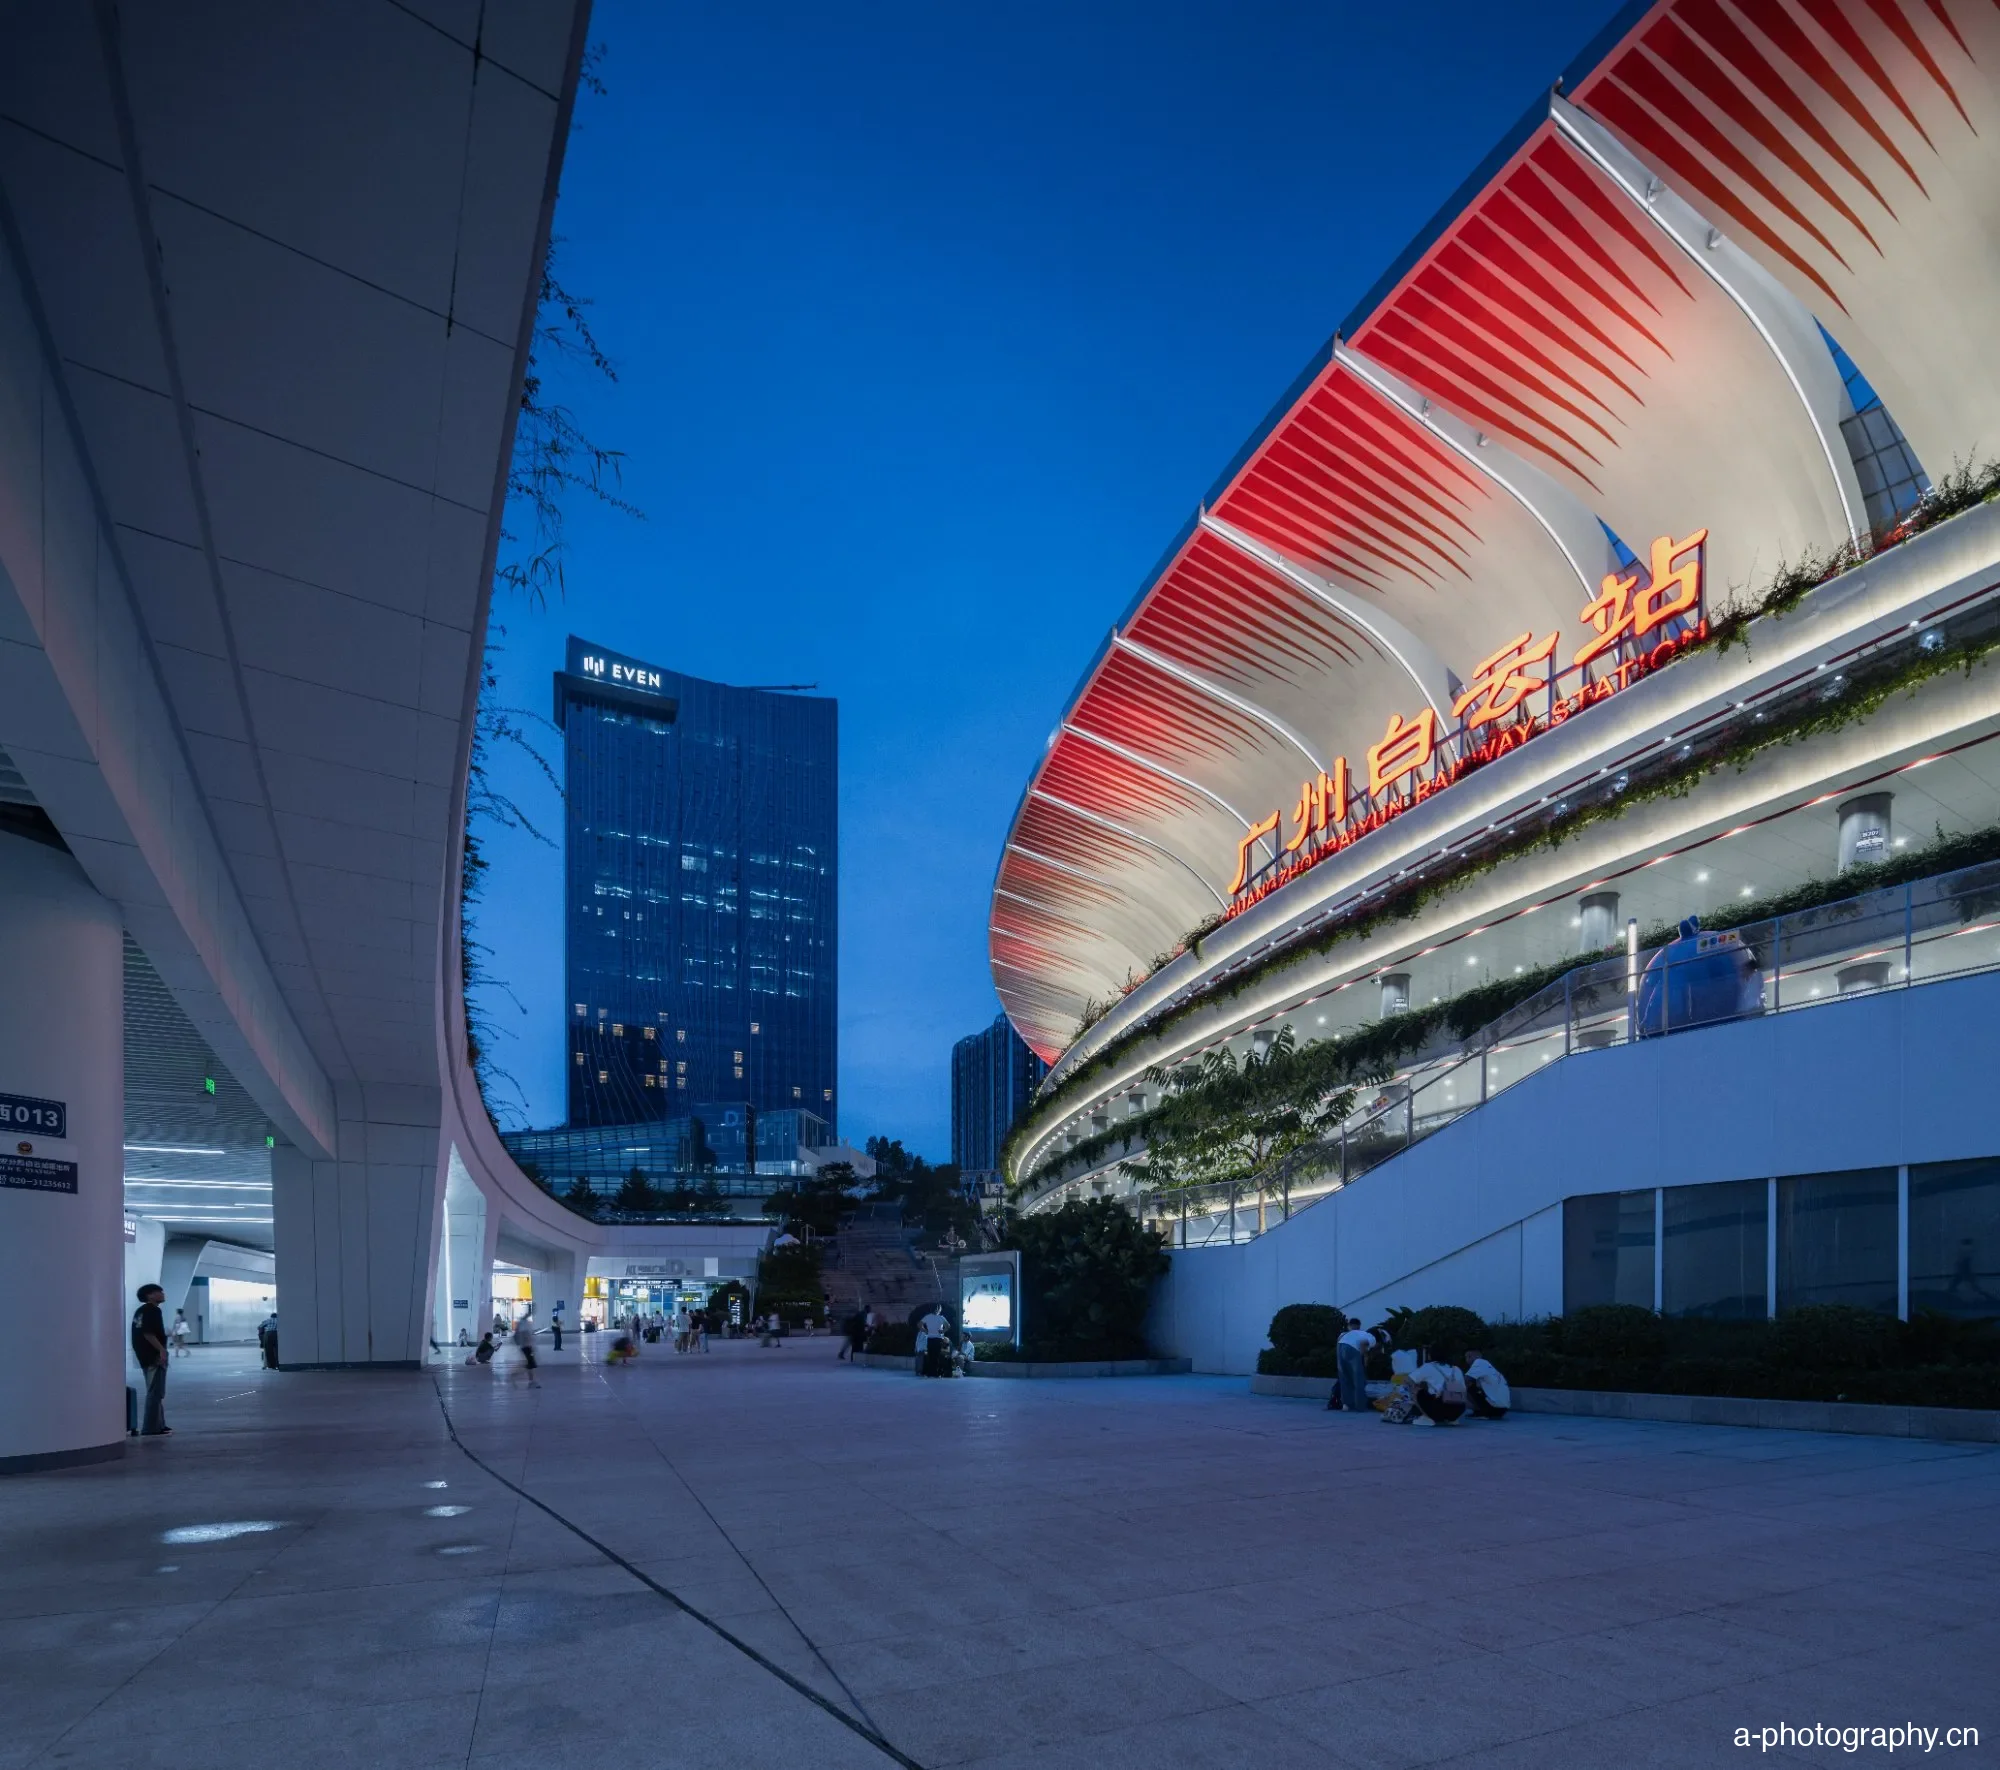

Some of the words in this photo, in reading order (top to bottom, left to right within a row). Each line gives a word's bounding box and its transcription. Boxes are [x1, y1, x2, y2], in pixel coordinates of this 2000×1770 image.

[612, 663, 660, 688] EVEN
[1227, 528, 1708, 896] 广州白云站
